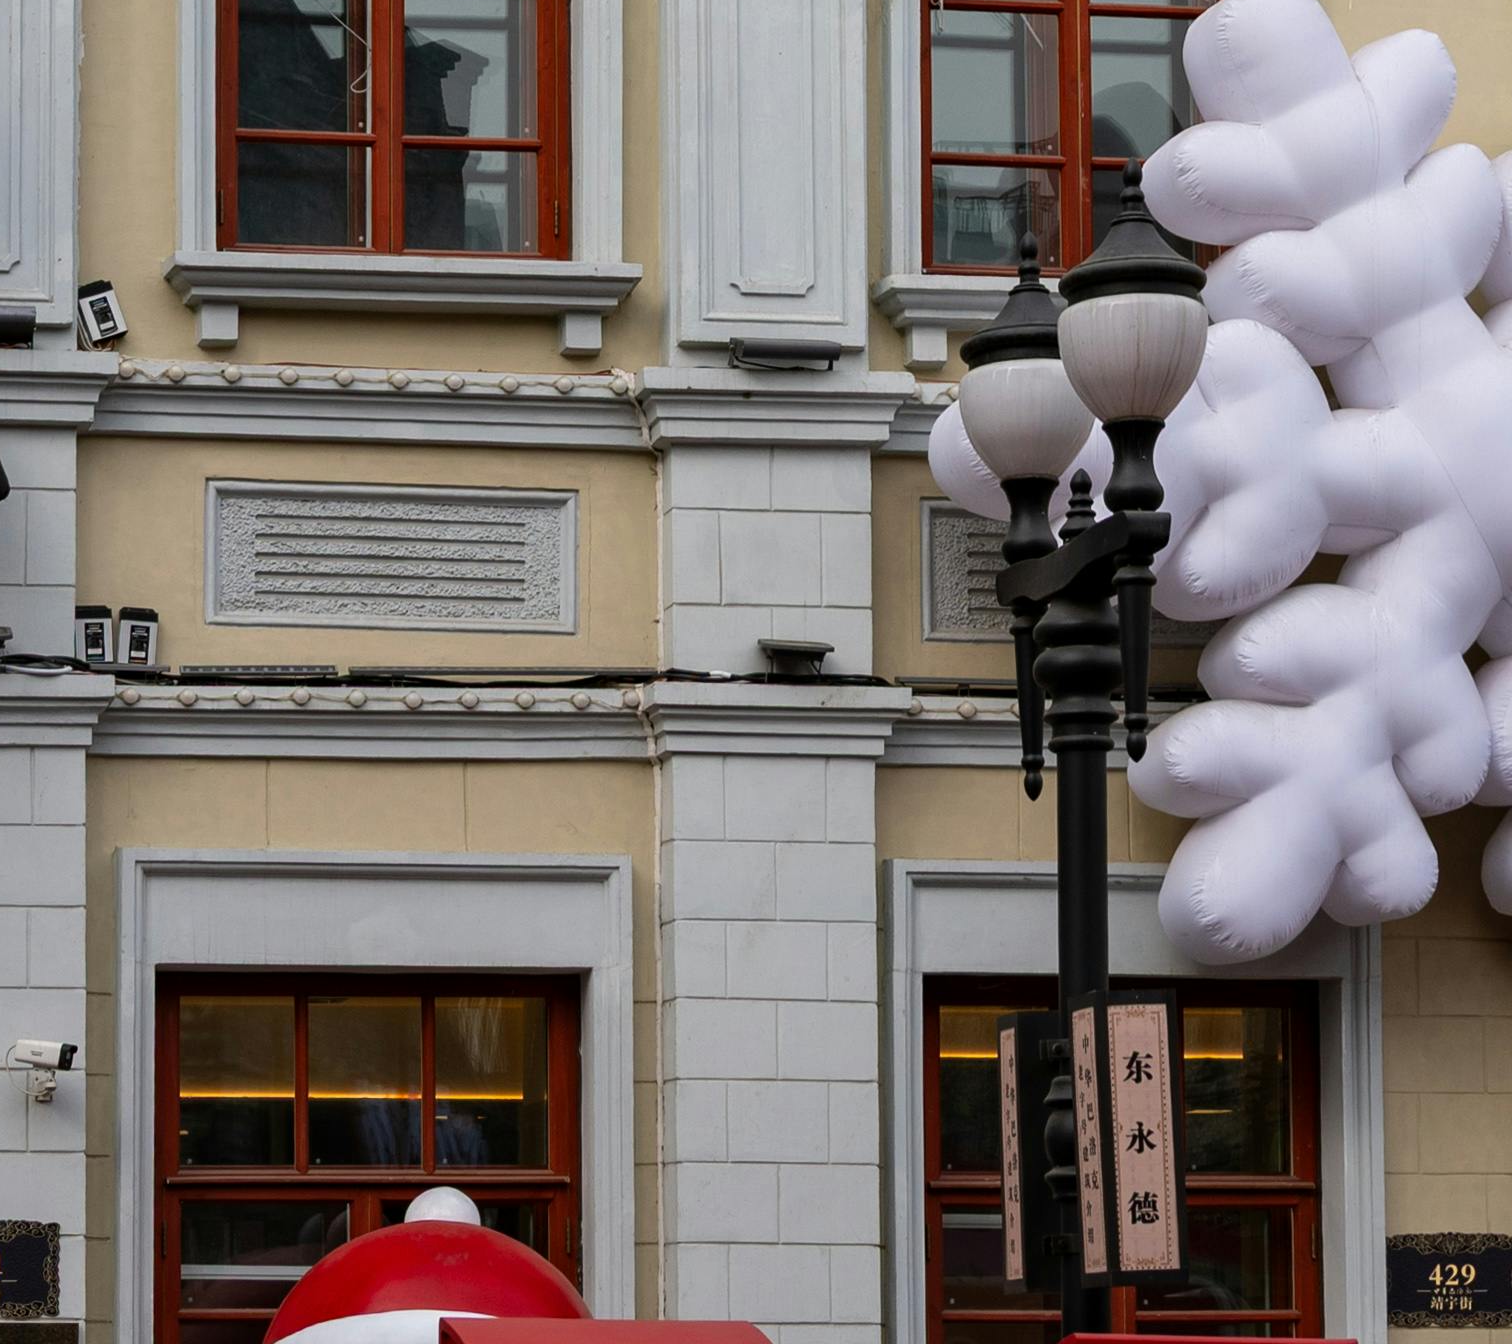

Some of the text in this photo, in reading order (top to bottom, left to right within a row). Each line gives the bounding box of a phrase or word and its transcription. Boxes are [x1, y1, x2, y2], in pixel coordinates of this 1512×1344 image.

[1122, 1050, 1160, 1225] 东永德
[1428, 1263, 1476, 1286] 429
